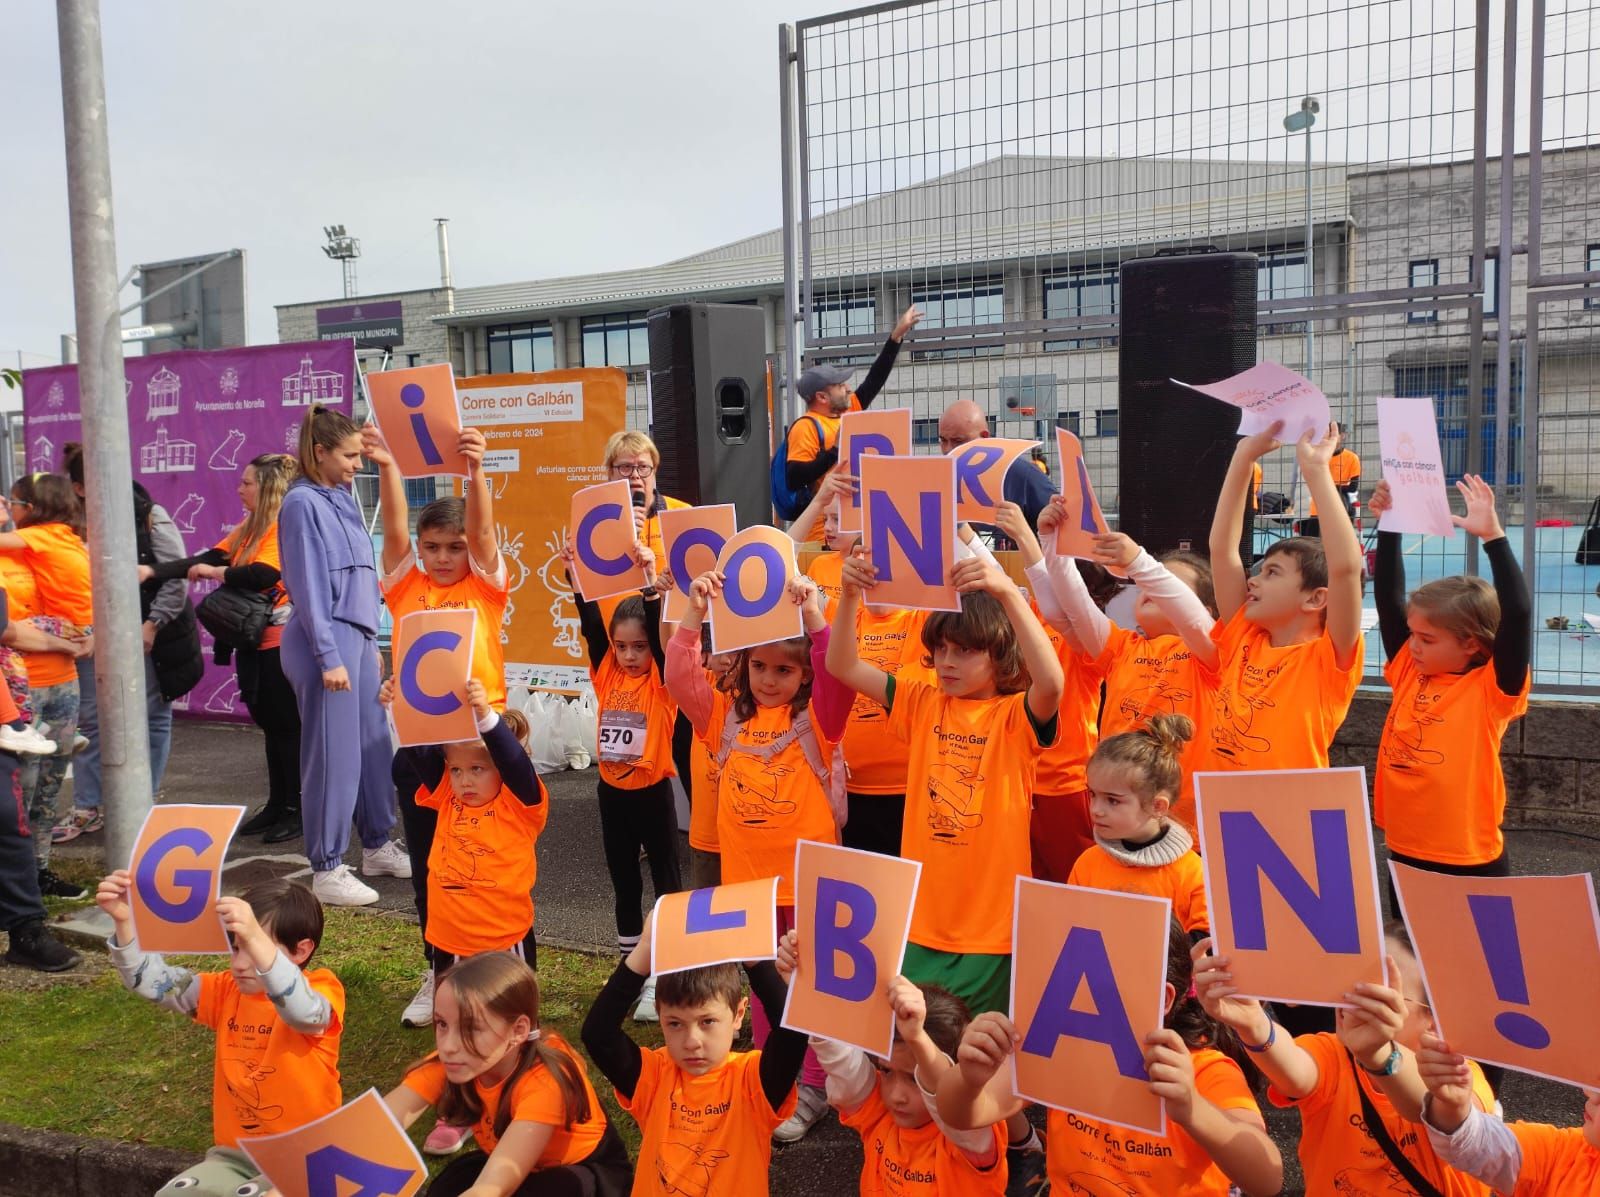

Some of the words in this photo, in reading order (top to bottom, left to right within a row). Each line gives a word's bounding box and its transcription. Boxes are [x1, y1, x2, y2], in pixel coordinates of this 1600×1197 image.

[366, 327, 399, 338] MUNICIPAL
[195, 401, 235, 412] Ayuntamiento
[235, 401, 243, 410] de
[243, 398, 265, 409] Noreña
[462, 396, 497, 410] Corre
[499, 396, 523, 408] con
[526, 389, 574, 406] Galbán
[512, 429, 523, 438] de
[524, 428, 544, 437] 2024
[566, 473, 591, 481] cáncer
[567, 464, 586, 473] corre
[957, 446, 1004, 507] R
[576, 503, 634, 576] C
[869, 490, 944, 586] N
[723, 542, 786, 617] O
[400, 630, 463, 716] C
[600, 728, 633, 745] 570
[136, 827, 213, 923] G
[1220, 809, 1361, 954] N
[686, 887, 746, 935] L
[815, 876, 877, 1002] B
[1467, 894, 1551, 1049] !
[1021, 926, 1150, 1081] A
[1067, 1113, 1100, 1139] Corre
[1125, 1140, 1173, 1157] Galbán
[306, 1145, 416, 1197] A
